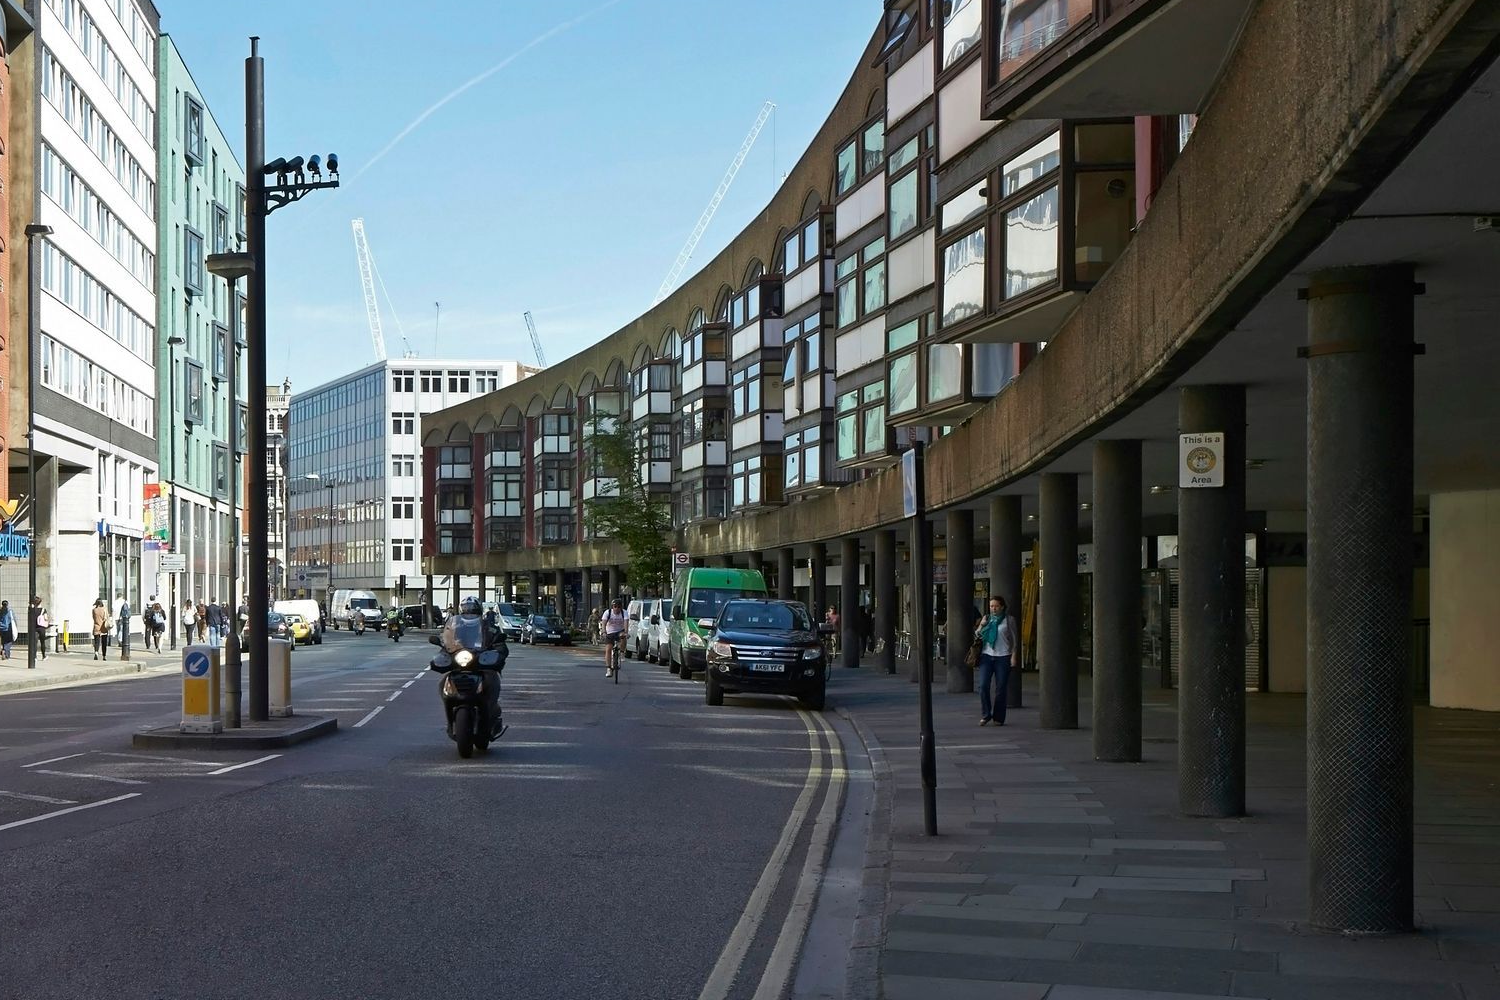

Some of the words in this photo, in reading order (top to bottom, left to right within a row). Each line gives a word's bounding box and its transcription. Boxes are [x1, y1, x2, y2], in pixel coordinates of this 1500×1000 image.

[1183, 436, 1202, 444] This
[1204, 436, 1213, 444] is
[1191, 476, 1212, 484] Area
